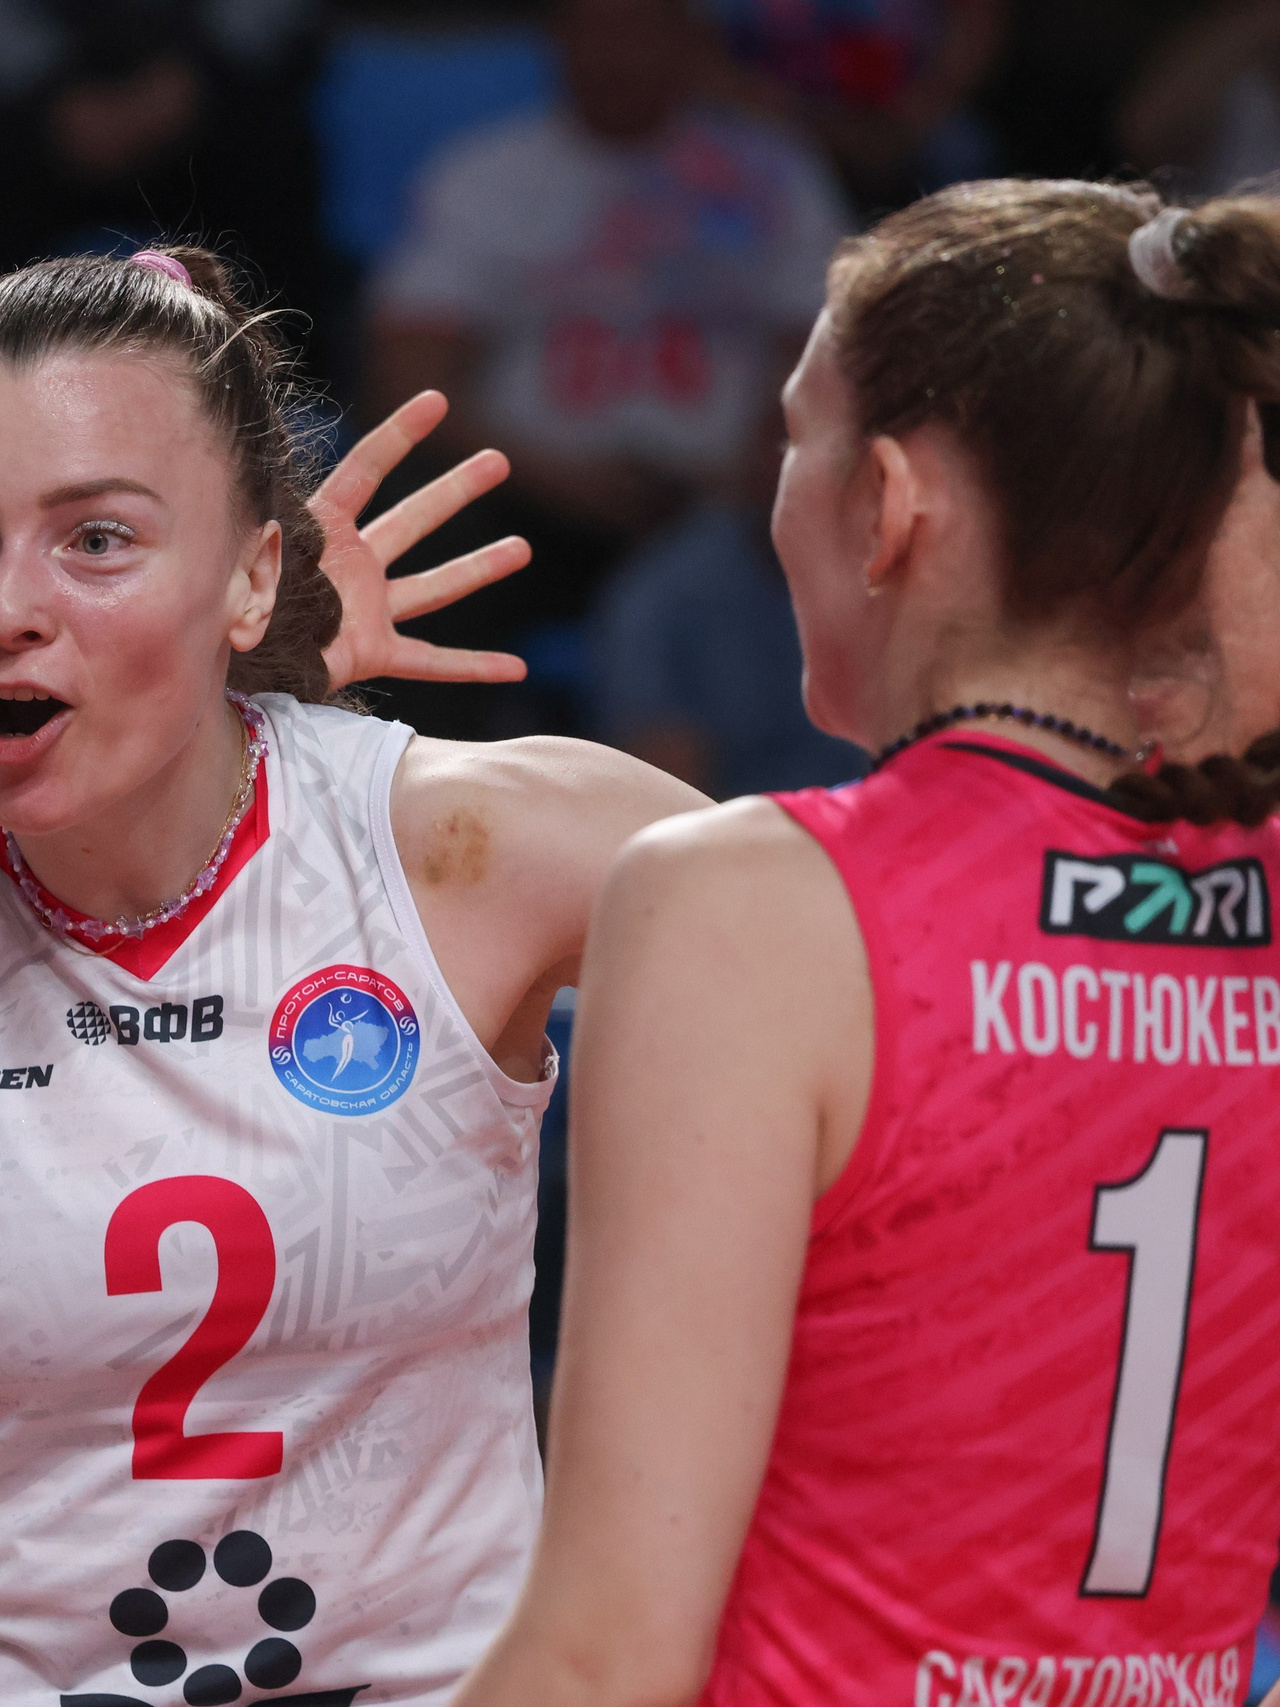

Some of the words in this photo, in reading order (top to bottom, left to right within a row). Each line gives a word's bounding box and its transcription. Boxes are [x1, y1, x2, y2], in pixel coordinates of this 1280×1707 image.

[1049, 858, 1263, 937] PARI
[109, 994, 224, 1045] ВФВ
[276, 971, 405, 1039] ПРОТОН-САРАТОВ
[284, 1069, 377, 1109] САРАТОВСКАЯ
[379, 1042, 414, 1100] ОБЛАСТЬ
[104, 1174, 284, 1480] 2
[1078, 1127, 1210, 1598] 1
